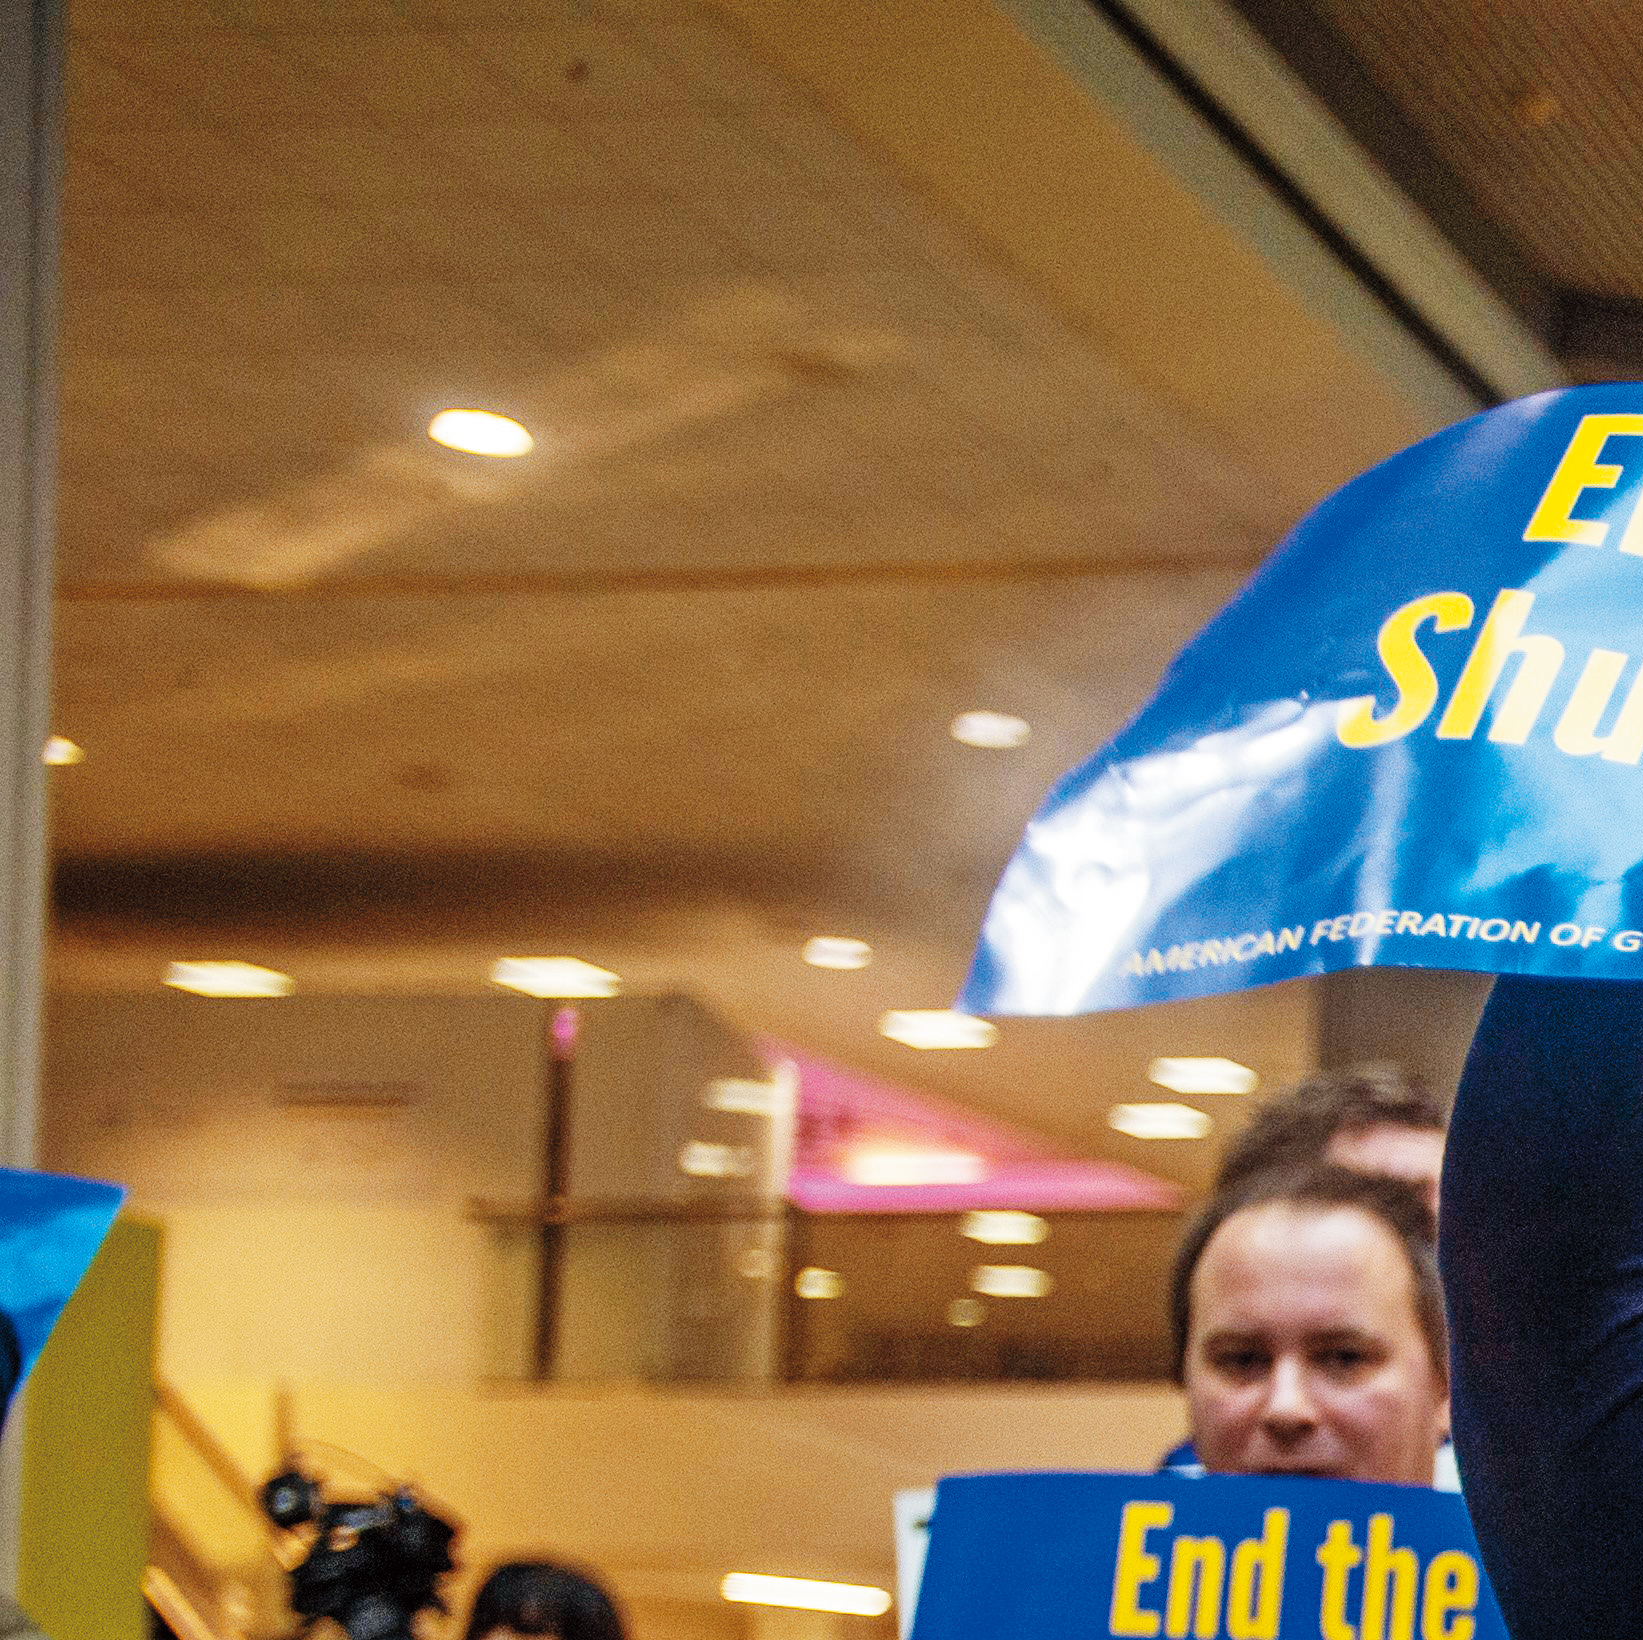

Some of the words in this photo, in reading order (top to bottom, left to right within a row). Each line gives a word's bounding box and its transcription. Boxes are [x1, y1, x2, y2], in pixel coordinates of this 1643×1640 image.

[1122, 926, 1304, 977] AMERICAN
[1310, 909, 1542, 948] FEDERATION
[1548, 921, 1608, 951] OF
